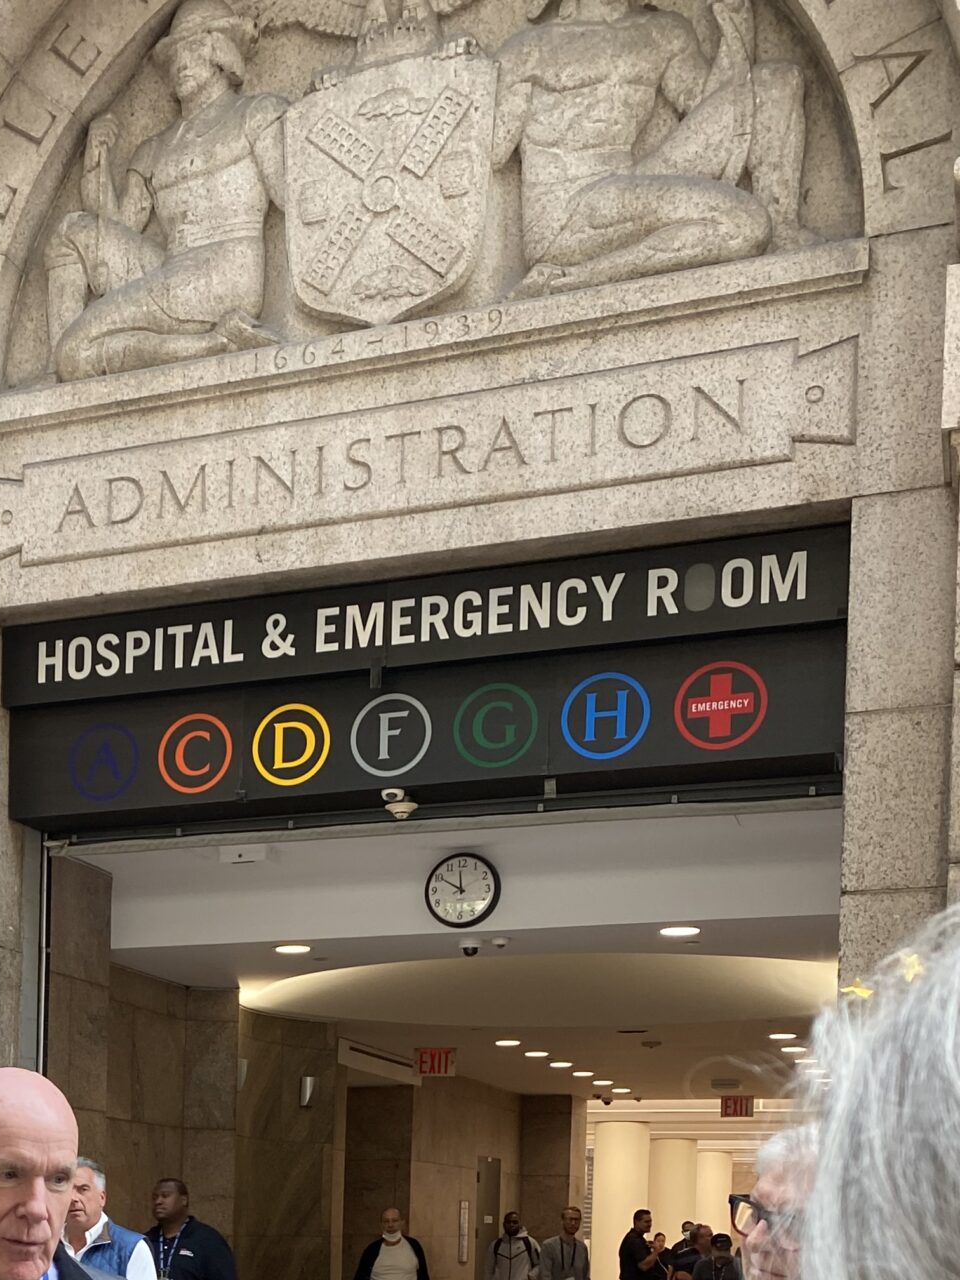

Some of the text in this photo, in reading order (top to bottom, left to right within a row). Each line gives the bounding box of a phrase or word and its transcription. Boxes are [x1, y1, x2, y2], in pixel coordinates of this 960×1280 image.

[840, 20, 953, 193] AL
[54, 377, 751, 533] ADMINISTRATION
[36, 550, 810, 686] HOSPITAL & EMERGENCY ROM
[175, 730, 211, 776] C
[273, 721, 316, 769] D
[378, 710, 410, 760] F
[472, 699, 517, 748] G
[585, 691, 632, 741] H
[691, 698, 750, 713] EMERGENCY
[419, 1050, 451, 1074] EXIT
[722, 1097, 753, 1116] EXIT
